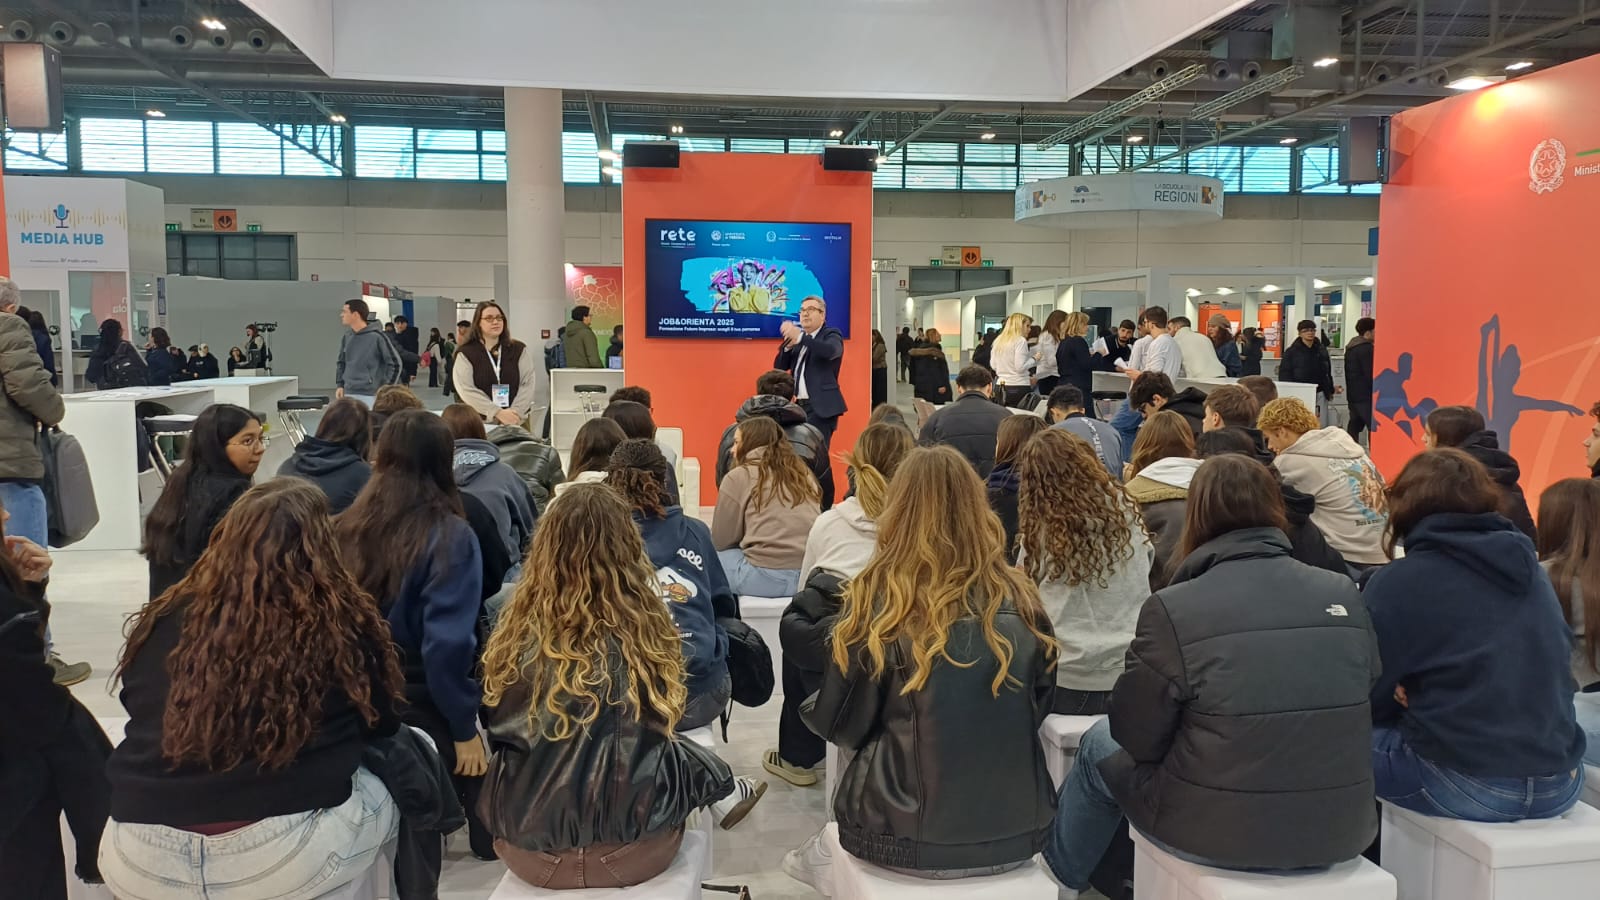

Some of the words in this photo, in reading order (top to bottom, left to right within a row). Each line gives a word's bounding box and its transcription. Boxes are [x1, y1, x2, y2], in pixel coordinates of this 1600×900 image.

[1154, 190, 1199, 203] REGIONI
[21, 232, 69, 244] MEDIA
[73, 233, 104, 245] HUB
[660, 228, 696, 241] rete
[716, 318, 734, 326] 2025
